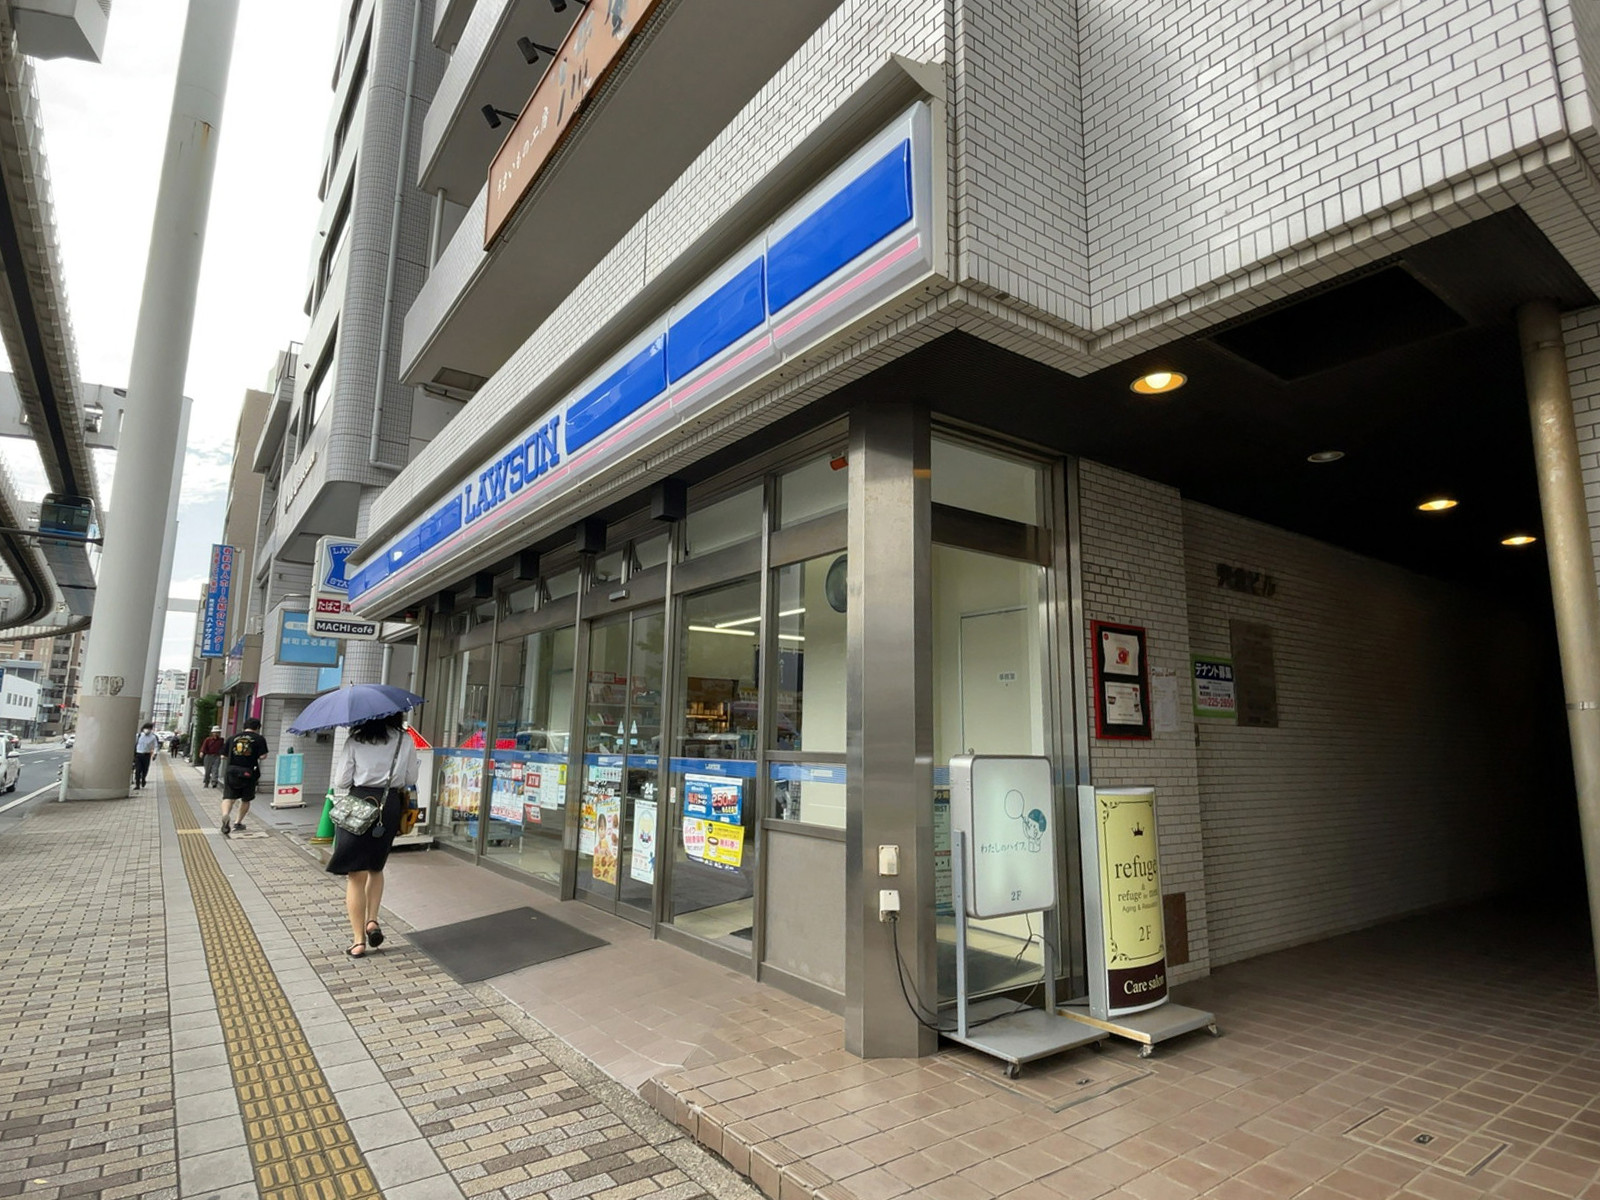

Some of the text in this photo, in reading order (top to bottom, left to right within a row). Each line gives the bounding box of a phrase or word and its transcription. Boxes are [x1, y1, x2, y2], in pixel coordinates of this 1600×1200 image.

[464, 415, 560, 524] LAWSON
[329, 577, 349, 589] STA
[317, 601, 340, 612] たばこ
[316, 622, 351, 633] MACHI
[352, 623, 375, 634] café
[1195, 663, 1233, 680] テナント募集
[1011, 890, 1021, 901] 2F
[1117, 889, 1142, 902] refuge
[1138, 925, 1152, 942] 2F
[1123, 979, 1147, 995] Care
